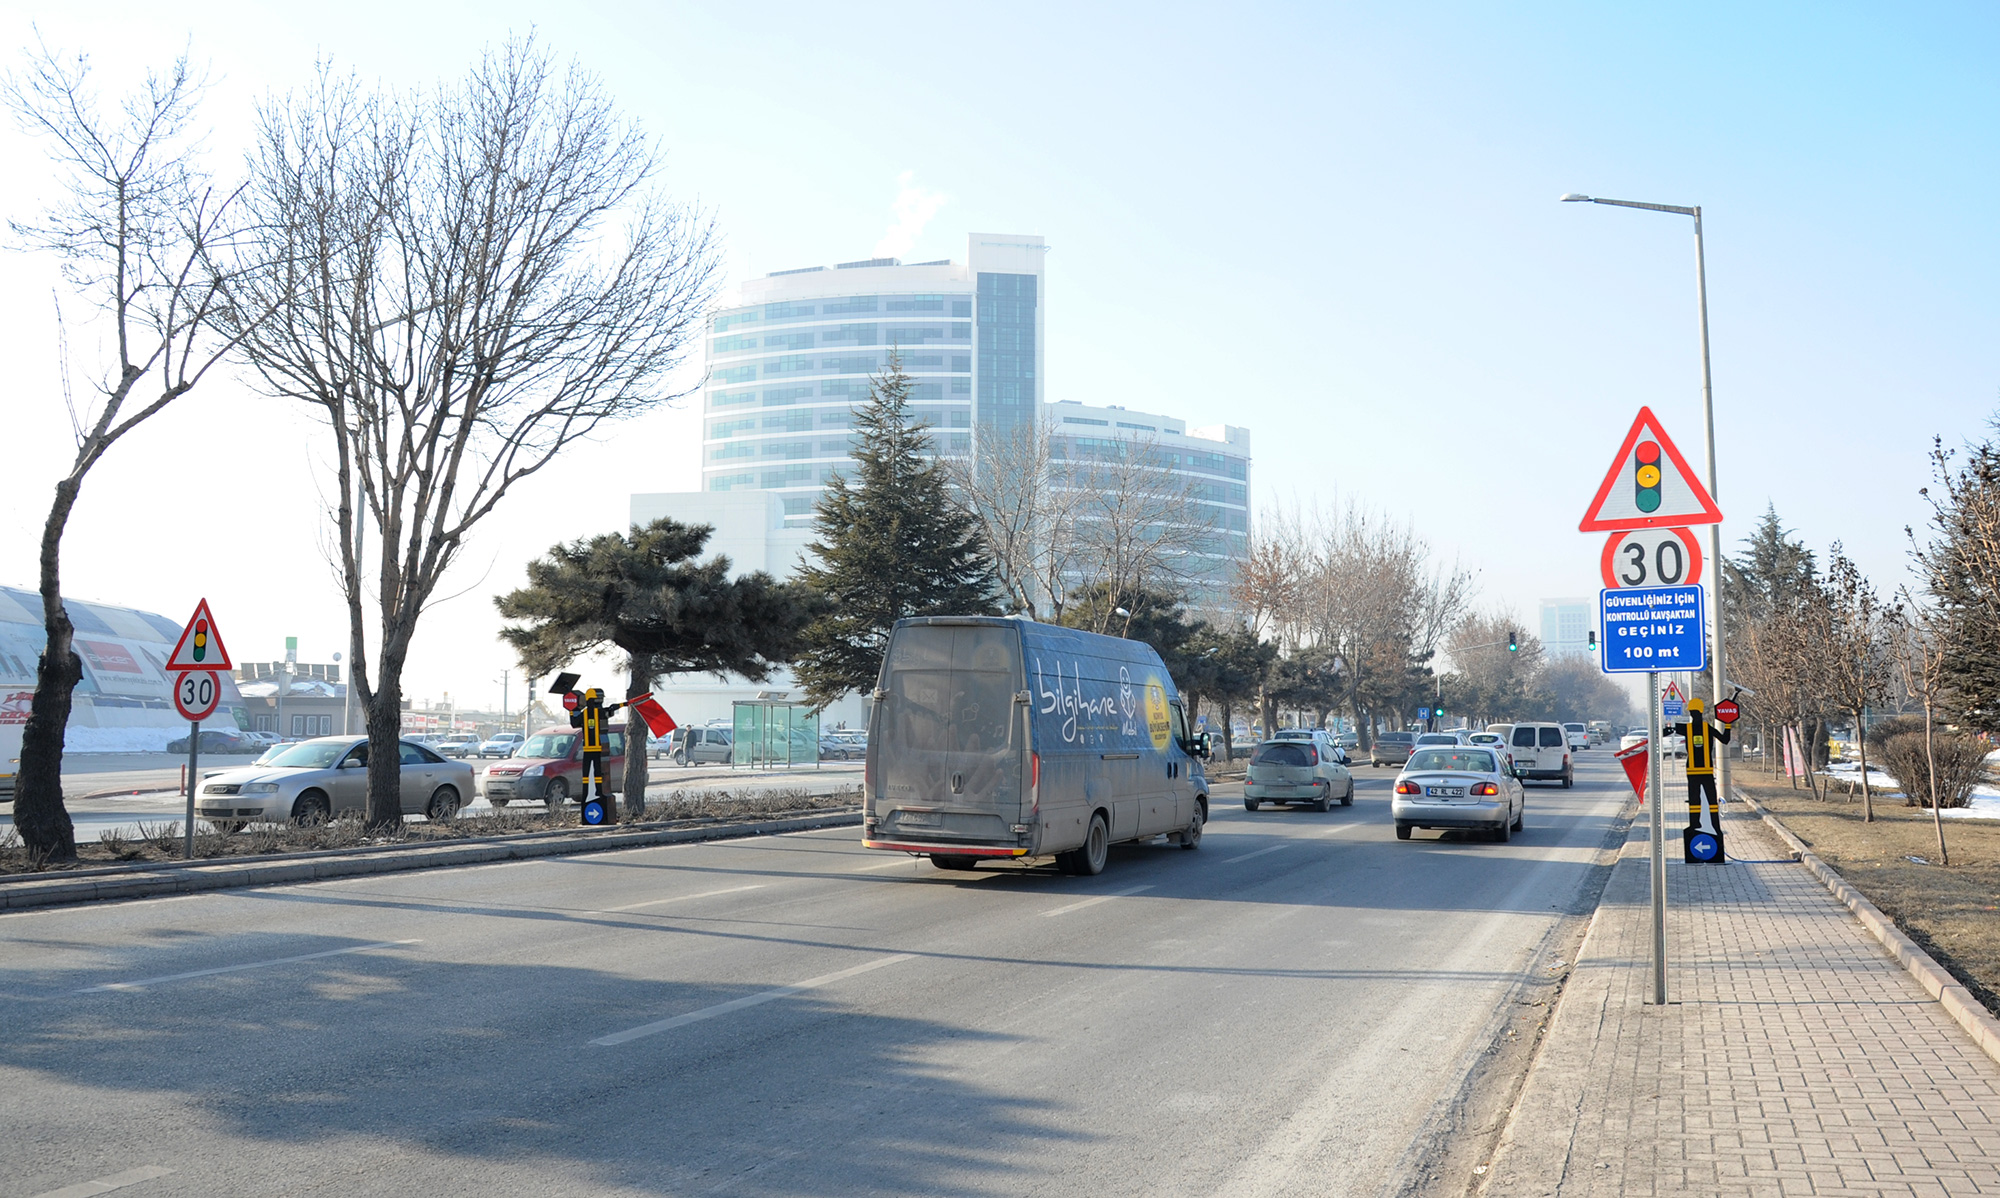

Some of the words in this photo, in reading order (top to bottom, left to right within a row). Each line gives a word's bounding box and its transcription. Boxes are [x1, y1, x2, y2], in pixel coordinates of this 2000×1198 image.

[1622, 541, 1682, 586] 30
[1606, 593, 1673, 608] GÜVENLİĞİNİZ
[1675, 592, 1695, 606] İÇİN
[1606, 610, 1650, 622] KONTROLLÜ
[1651, 609, 1695, 622] KAVŞAKTAN
[1618, 623, 1684, 638] GEÇİNİZ
[1624, 647, 1653, 658] 100
[1658, 646, 1679, 657] mt
[183, 679, 212, 705] 30
[1036, 657, 1118, 743] bilgihane
[1420, 709, 1427, 717] H
